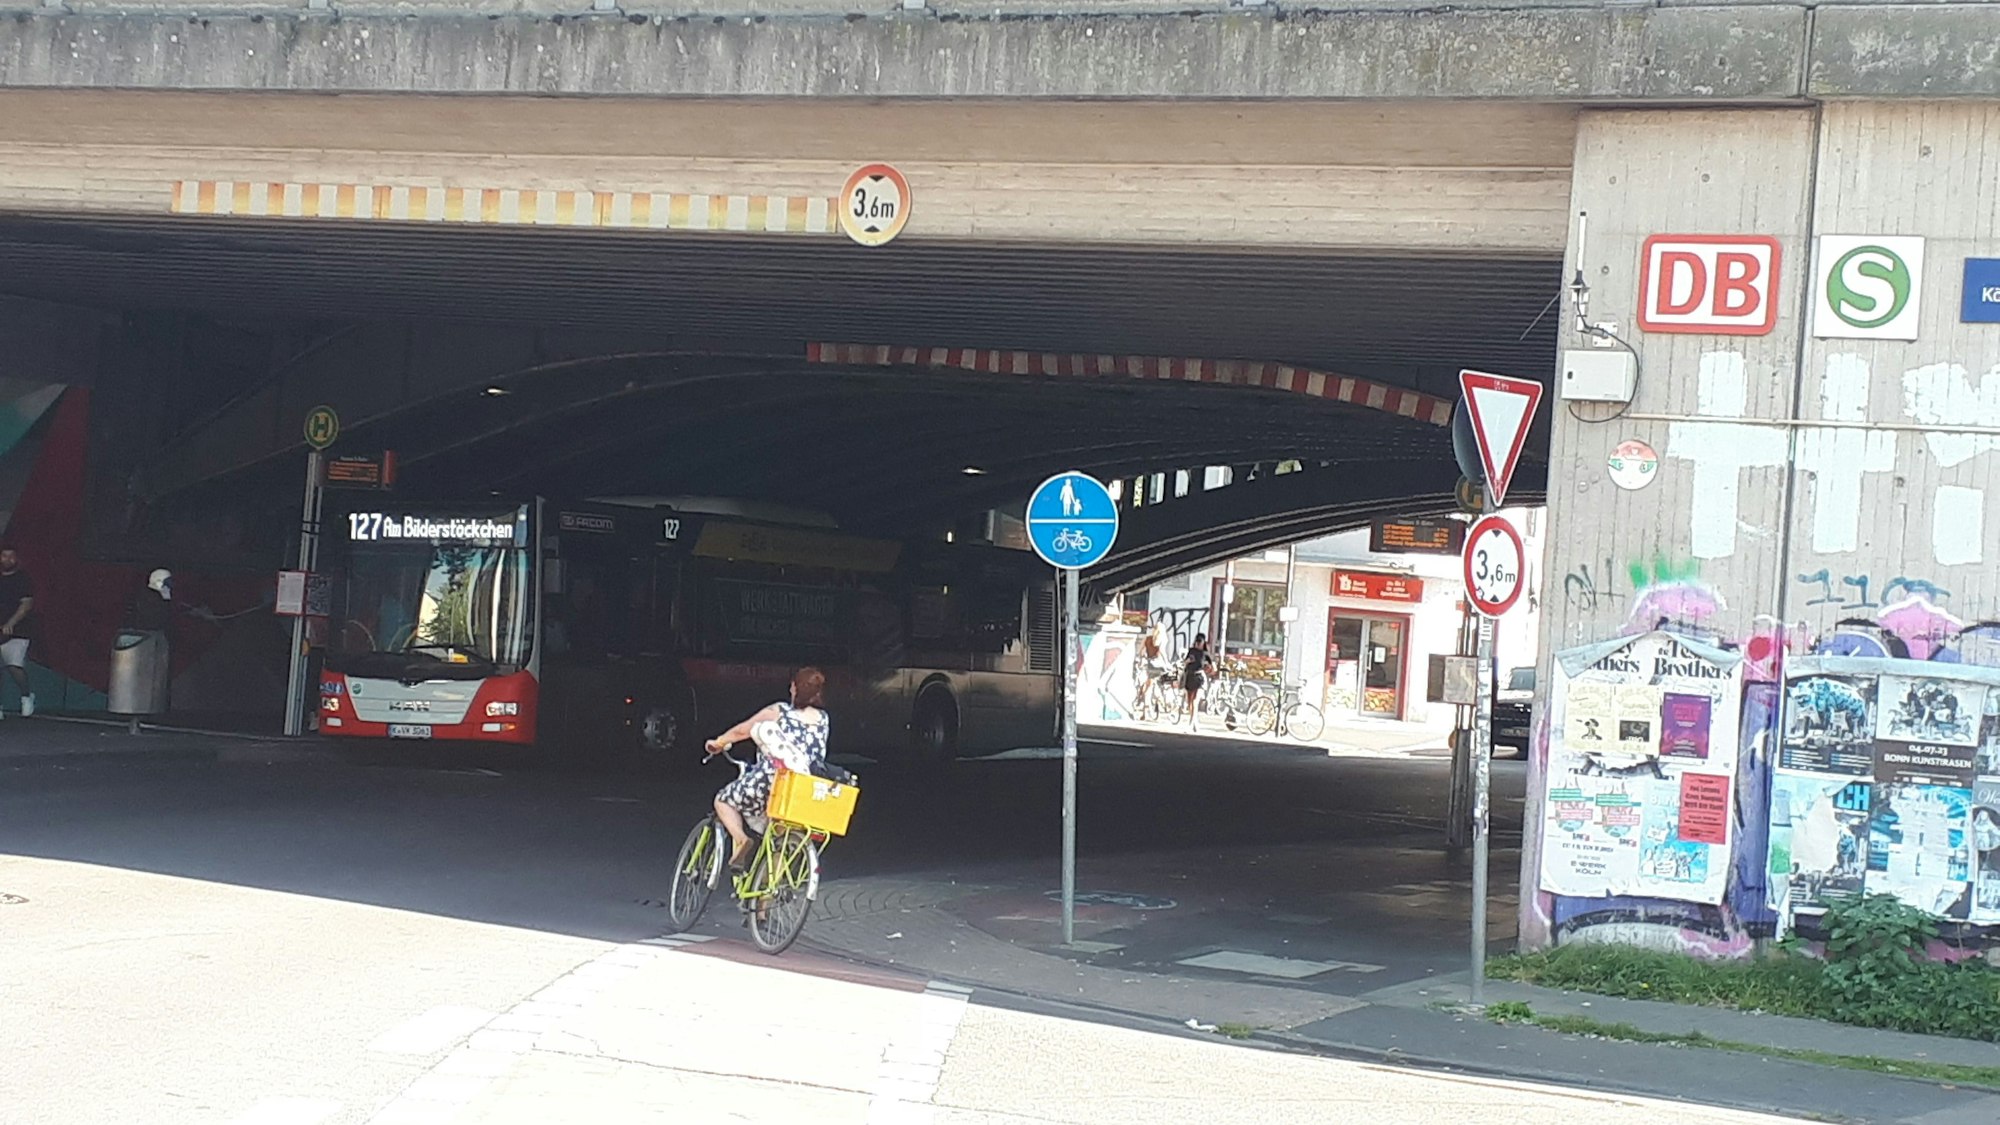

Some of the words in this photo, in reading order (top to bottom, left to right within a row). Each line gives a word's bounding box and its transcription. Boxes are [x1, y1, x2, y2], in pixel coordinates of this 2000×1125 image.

[1656, 251, 1761, 317] DB
[1839, 251, 1896, 322] S
[313, 415, 329, 439] H
[349, 513, 382, 541] 127
[383, 516, 401, 538] Am
[403, 516, 513, 539] Bilderstöckchen
[664, 519, 680, 539] 127
[1884, 753, 1910, 763] BONN
